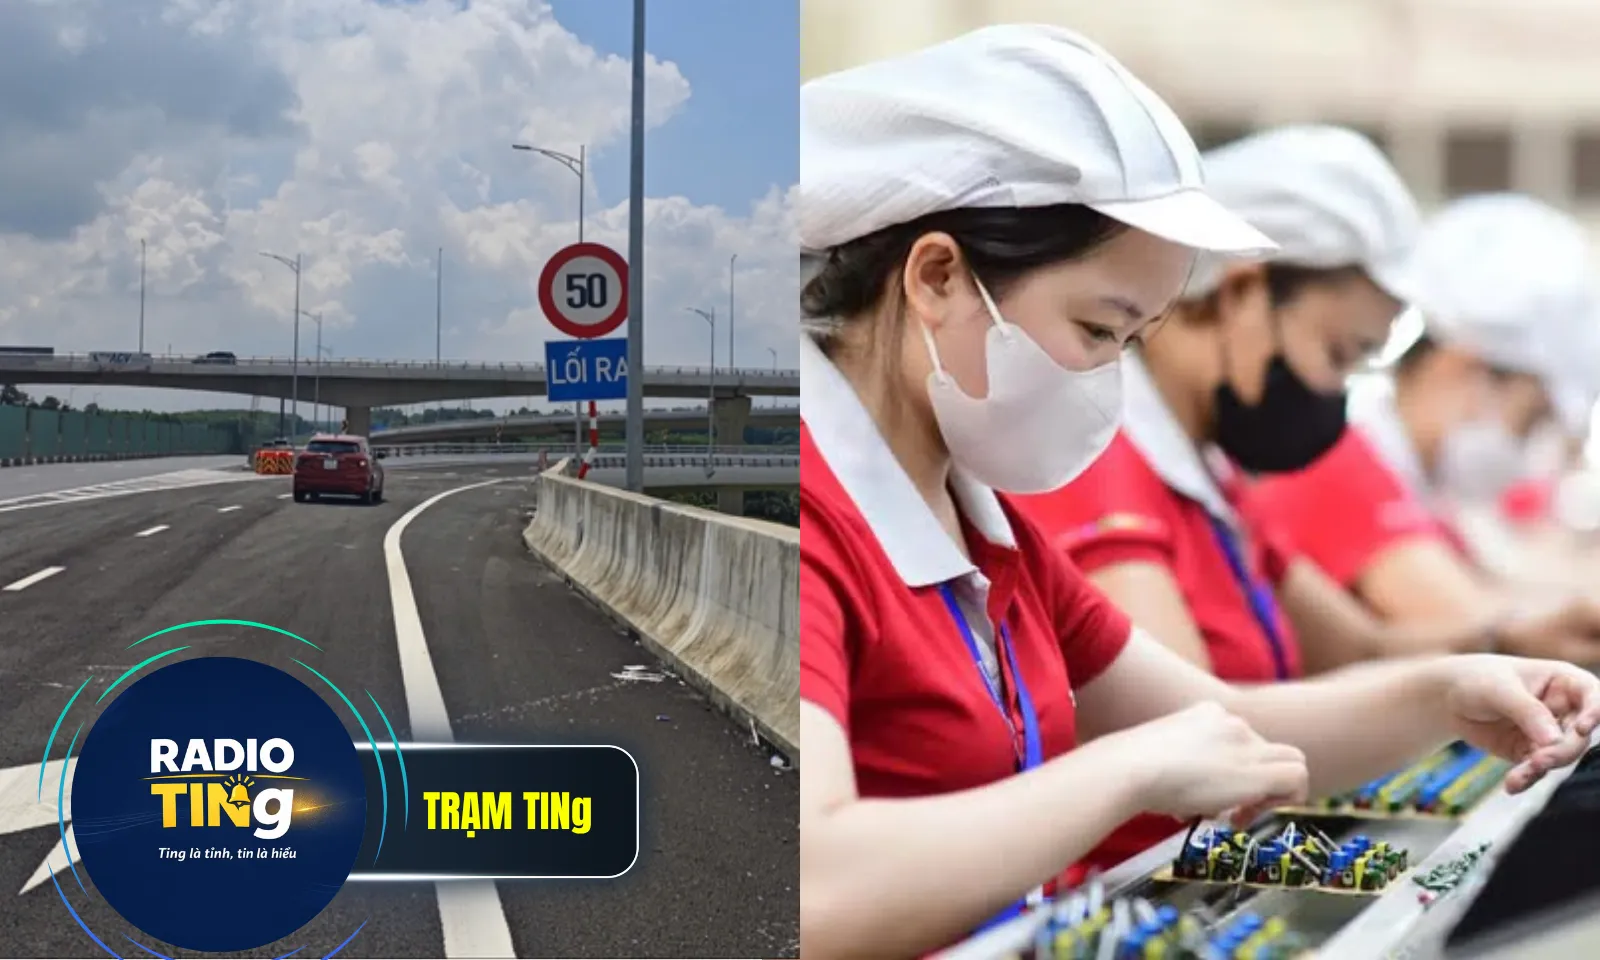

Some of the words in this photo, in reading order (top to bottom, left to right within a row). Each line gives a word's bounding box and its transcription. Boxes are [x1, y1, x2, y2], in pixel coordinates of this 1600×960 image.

[566, 273, 607, 309] 50
[552, 346, 587, 384] LỐI
[596, 357, 628, 383] RA
